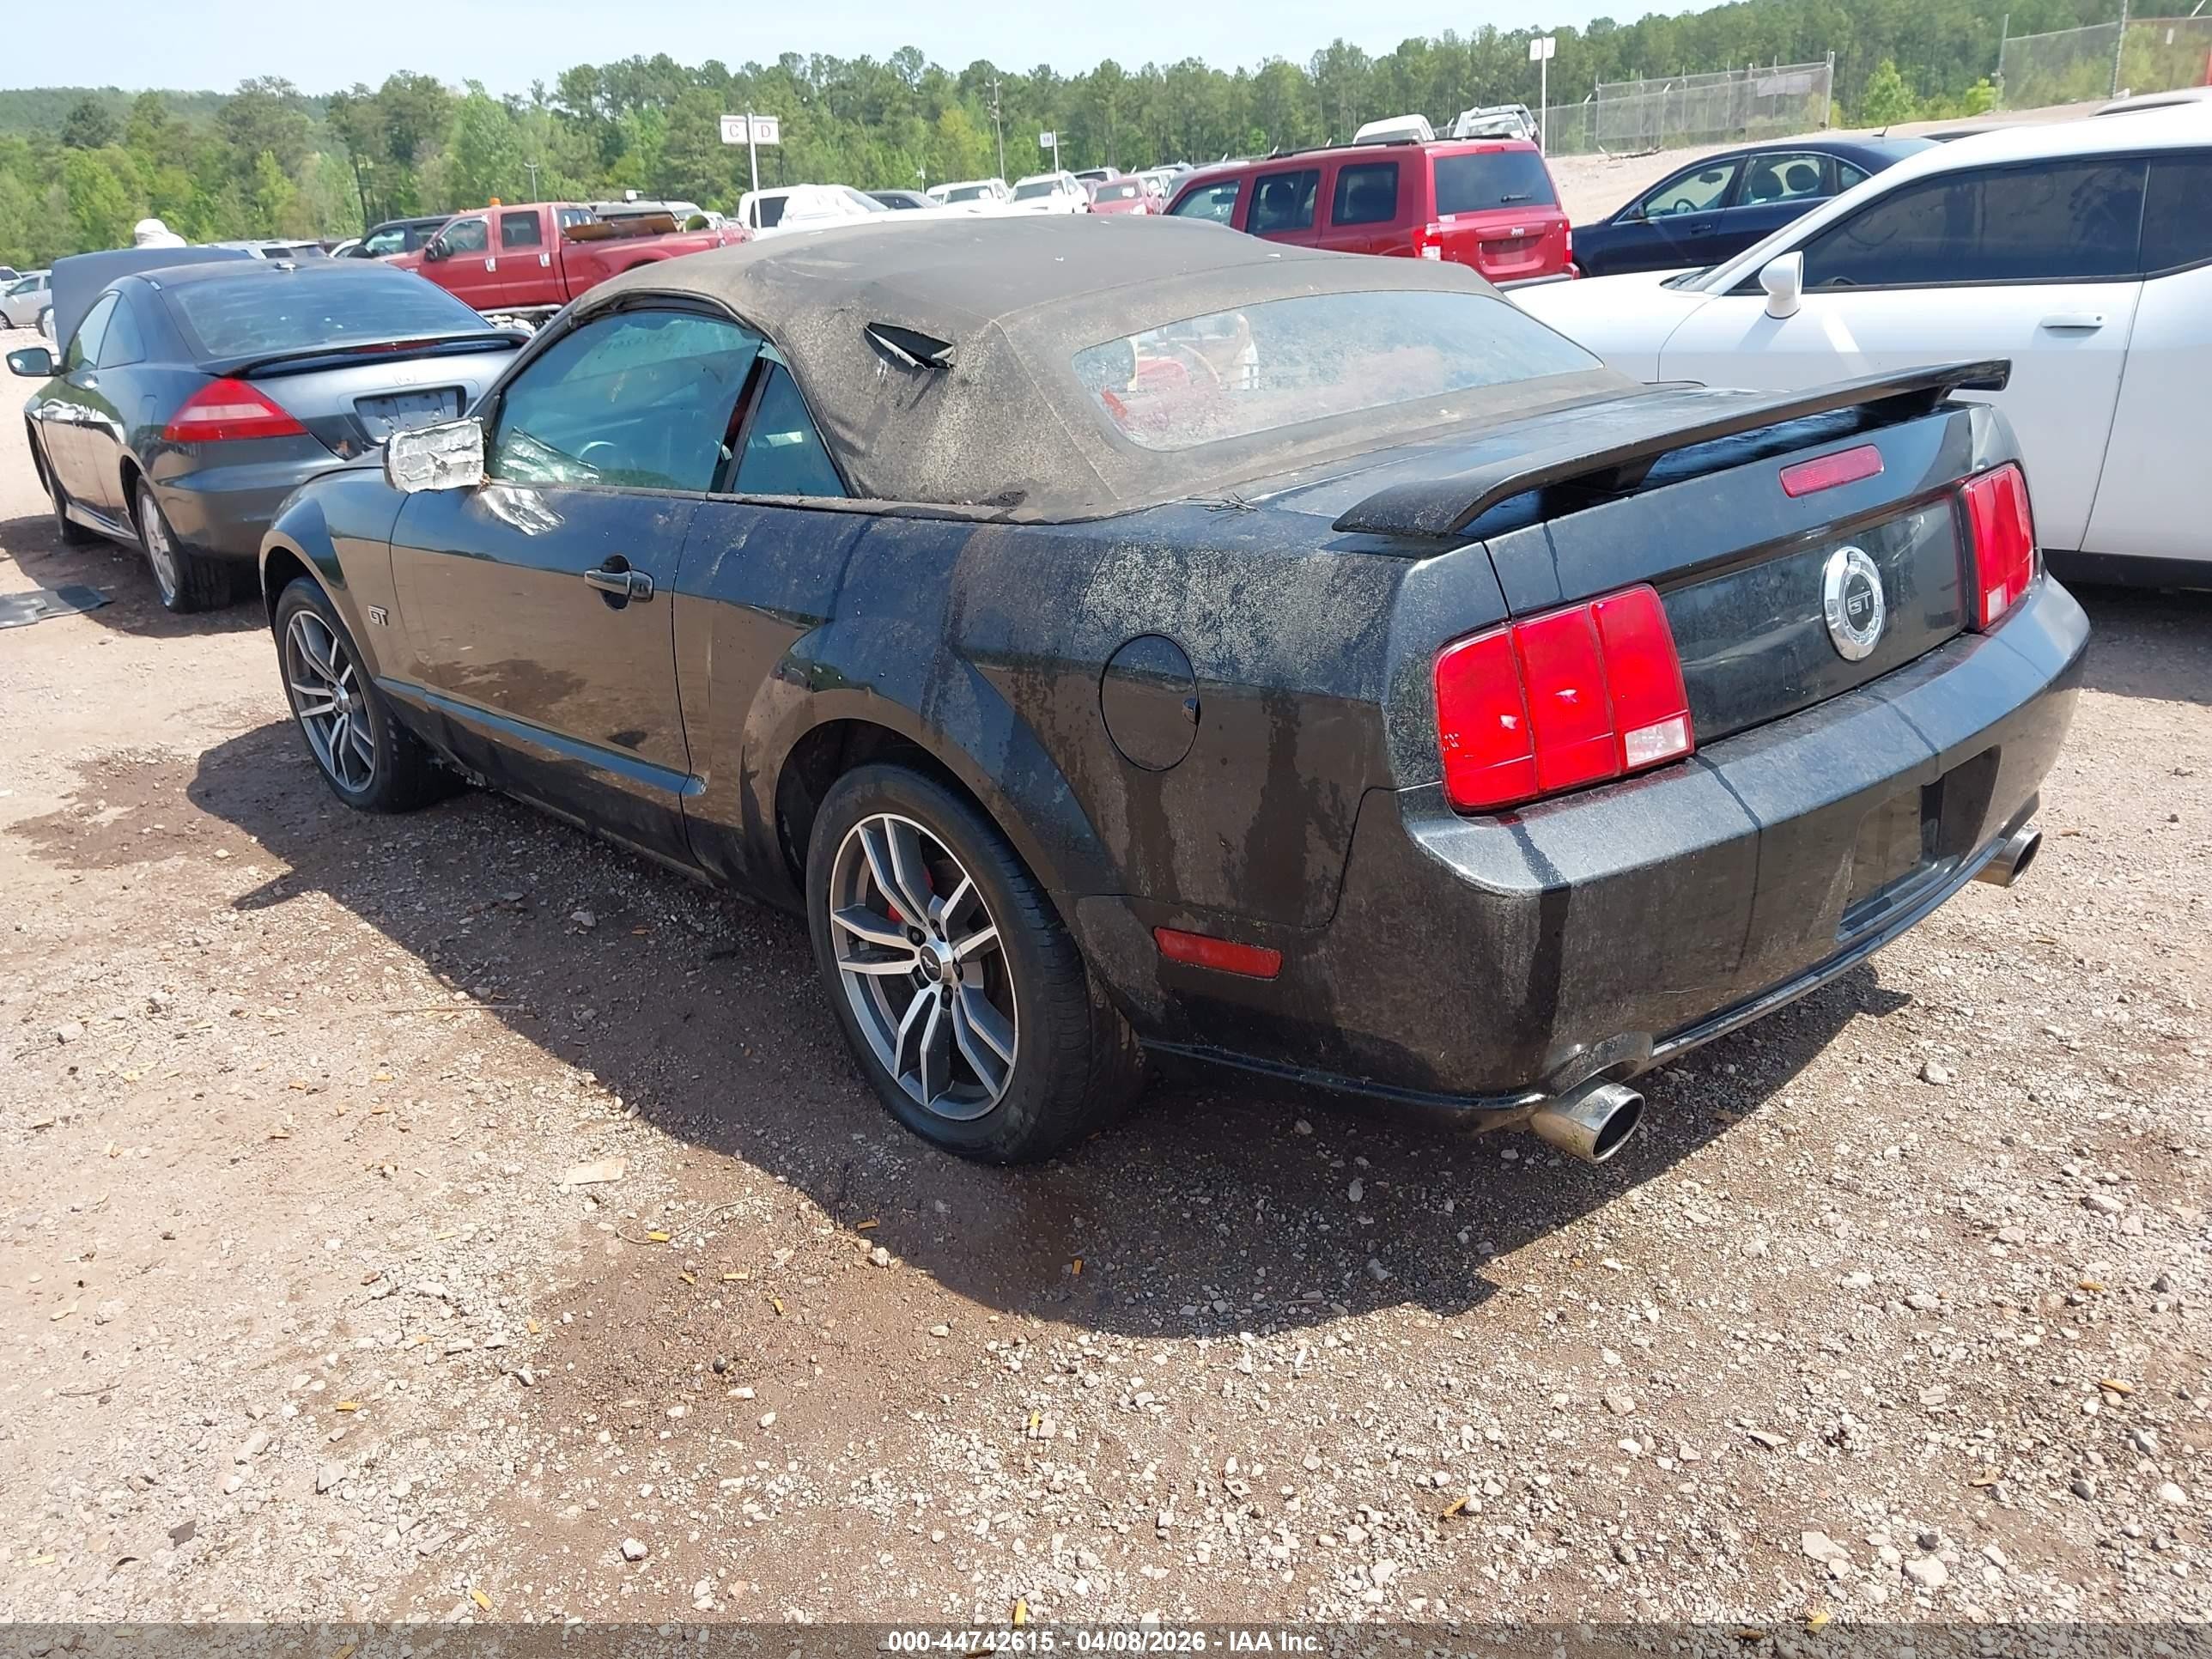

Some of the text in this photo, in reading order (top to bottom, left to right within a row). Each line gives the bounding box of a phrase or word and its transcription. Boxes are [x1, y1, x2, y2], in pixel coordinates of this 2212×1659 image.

[729, 123, 739, 138] C
[761, 125, 771, 138] D
[1847, 590, 1872, 616] GT
[367, 605, 389, 626] GT
